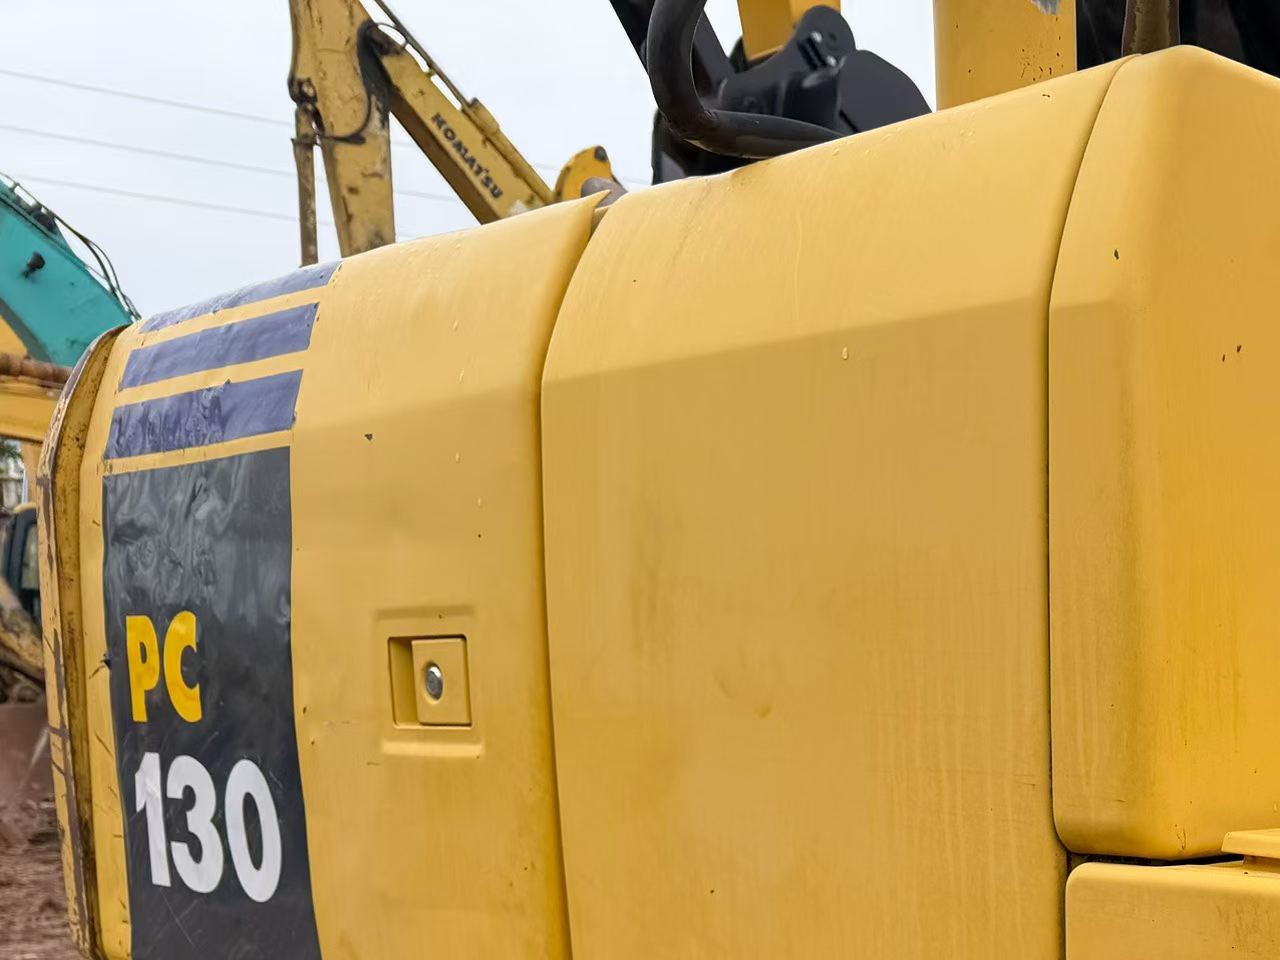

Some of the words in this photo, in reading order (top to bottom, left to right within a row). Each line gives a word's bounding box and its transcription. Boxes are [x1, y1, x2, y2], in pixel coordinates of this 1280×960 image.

[431, 112, 503, 199] KOMATSU
[126, 611, 202, 723] PC
[135, 751, 282, 903] 130
